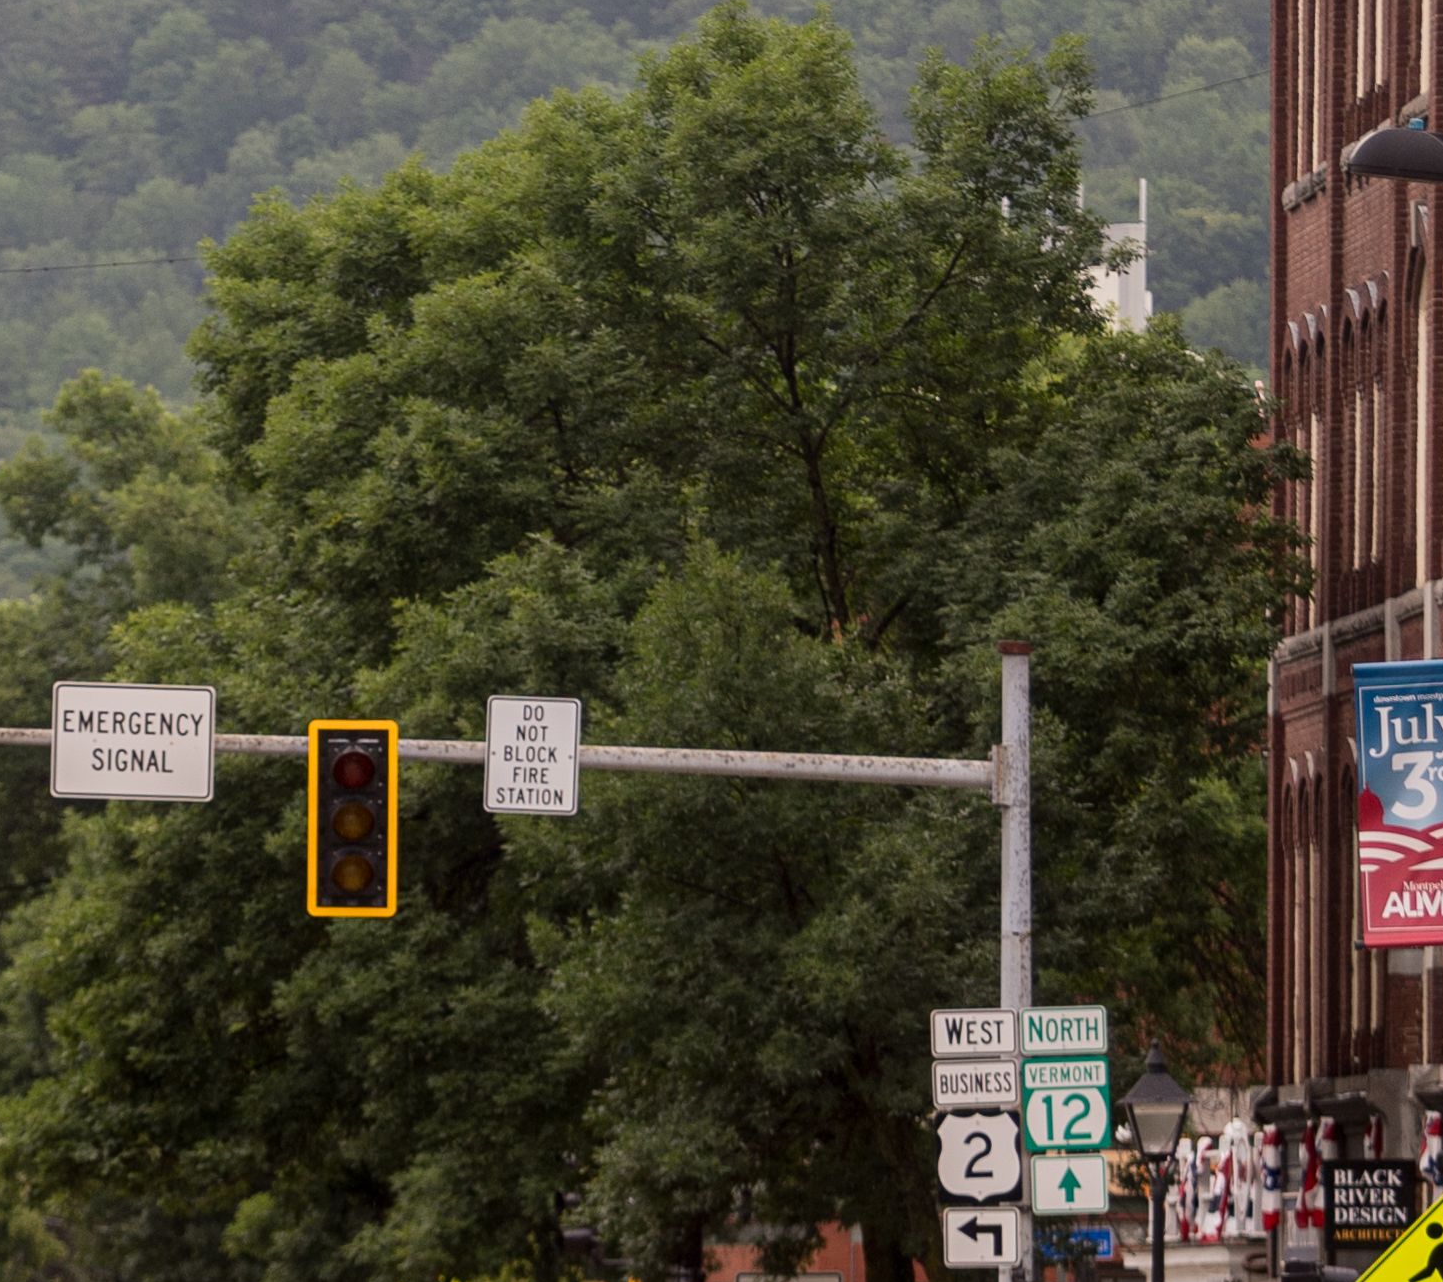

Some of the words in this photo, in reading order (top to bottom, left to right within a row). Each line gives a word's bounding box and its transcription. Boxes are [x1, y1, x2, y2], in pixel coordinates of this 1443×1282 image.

[62, 709, 205, 738] EMERGENCY
[523, 704, 545, 723] DO
[515, 725, 549, 743] NOT
[91, 747, 174, 774] SIGNAL
[503, 744, 559, 764] BLOCK
[513, 766, 550, 785] FIRE
[495, 787, 565, 806] STATION
[944, 1017, 1004, 1045] WEST
[1028, 1014, 1099, 1043] NORTH
[940, 1071, 1013, 1095] BUSINESS
[1028, 1064, 1102, 1084] VERMONT
[1041, 1092, 1092, 1142] 12
[963, 1131, 994, 1179] 2
[1333, 1169, 1403, 1188] BLACK
[1333, 1188, 1396, 1205] RIVER
[1333, 1206, 1408, 1225] DESIGN
